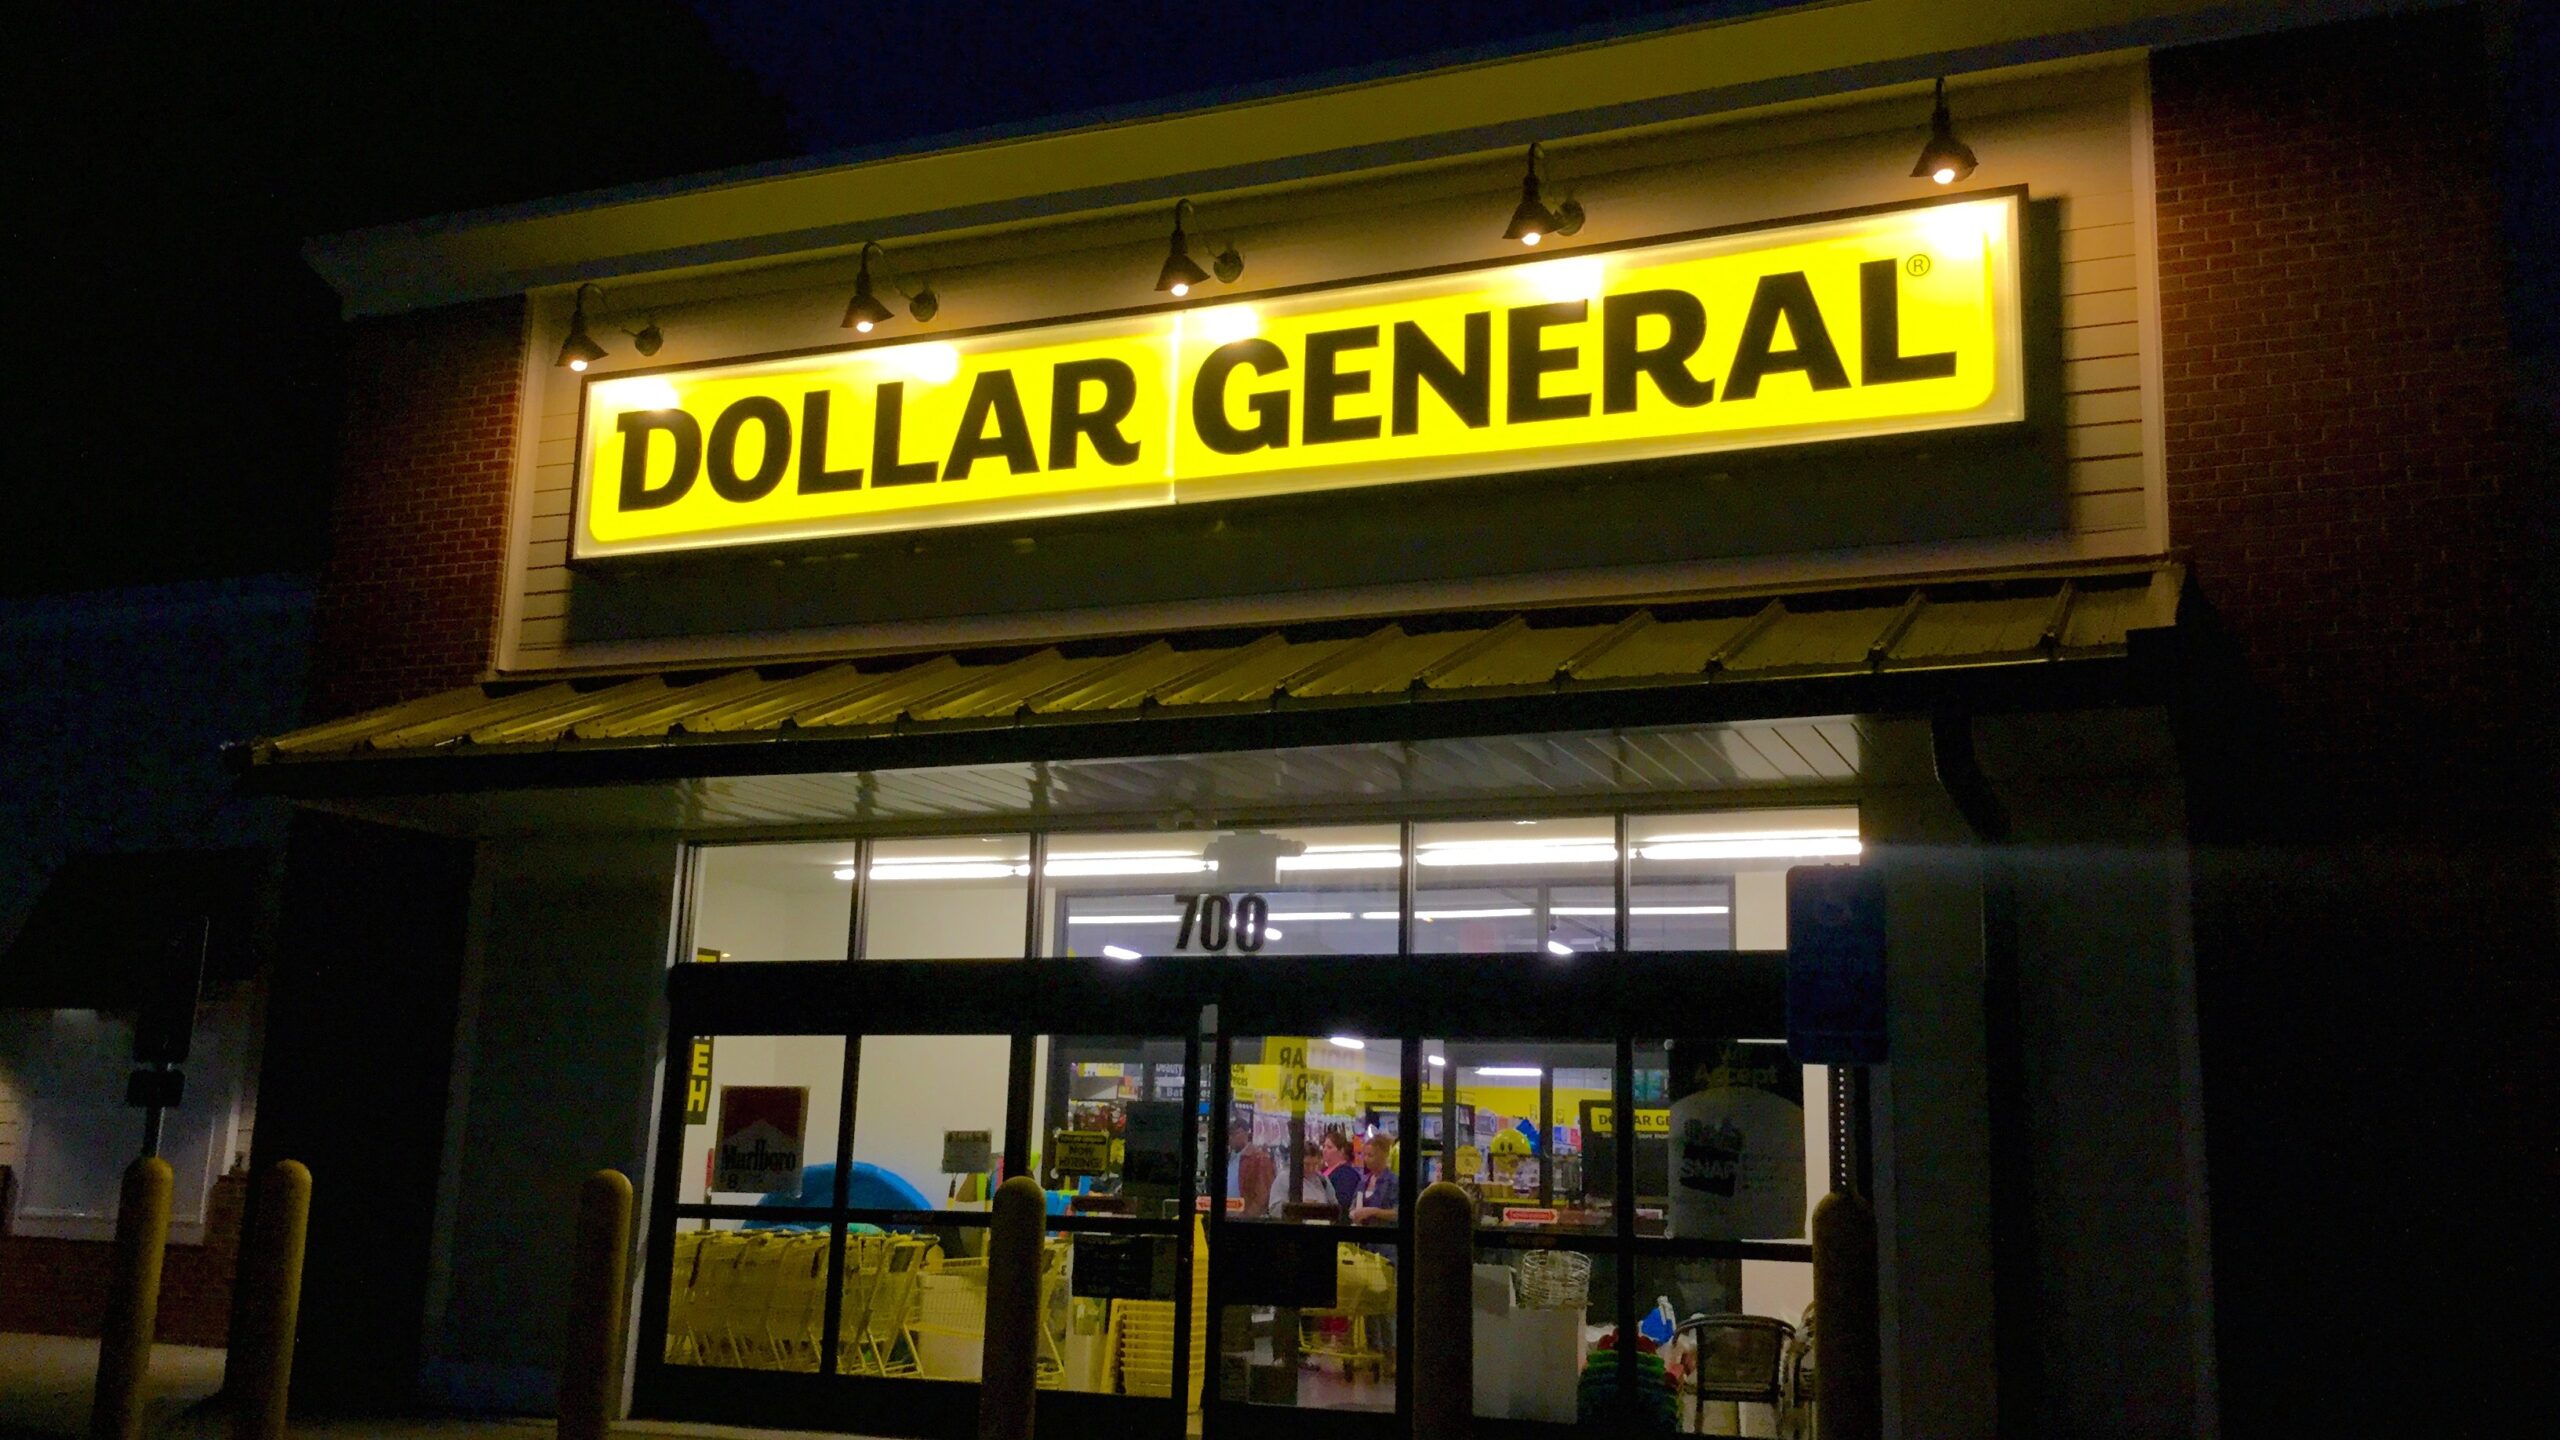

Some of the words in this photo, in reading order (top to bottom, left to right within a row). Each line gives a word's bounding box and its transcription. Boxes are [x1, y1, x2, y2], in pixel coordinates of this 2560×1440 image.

[616, 358, 1142, 512] DOLLAR
[1192, 258, 1957, 455] GENERAL
[1174, 894, 1269, 952] 700
